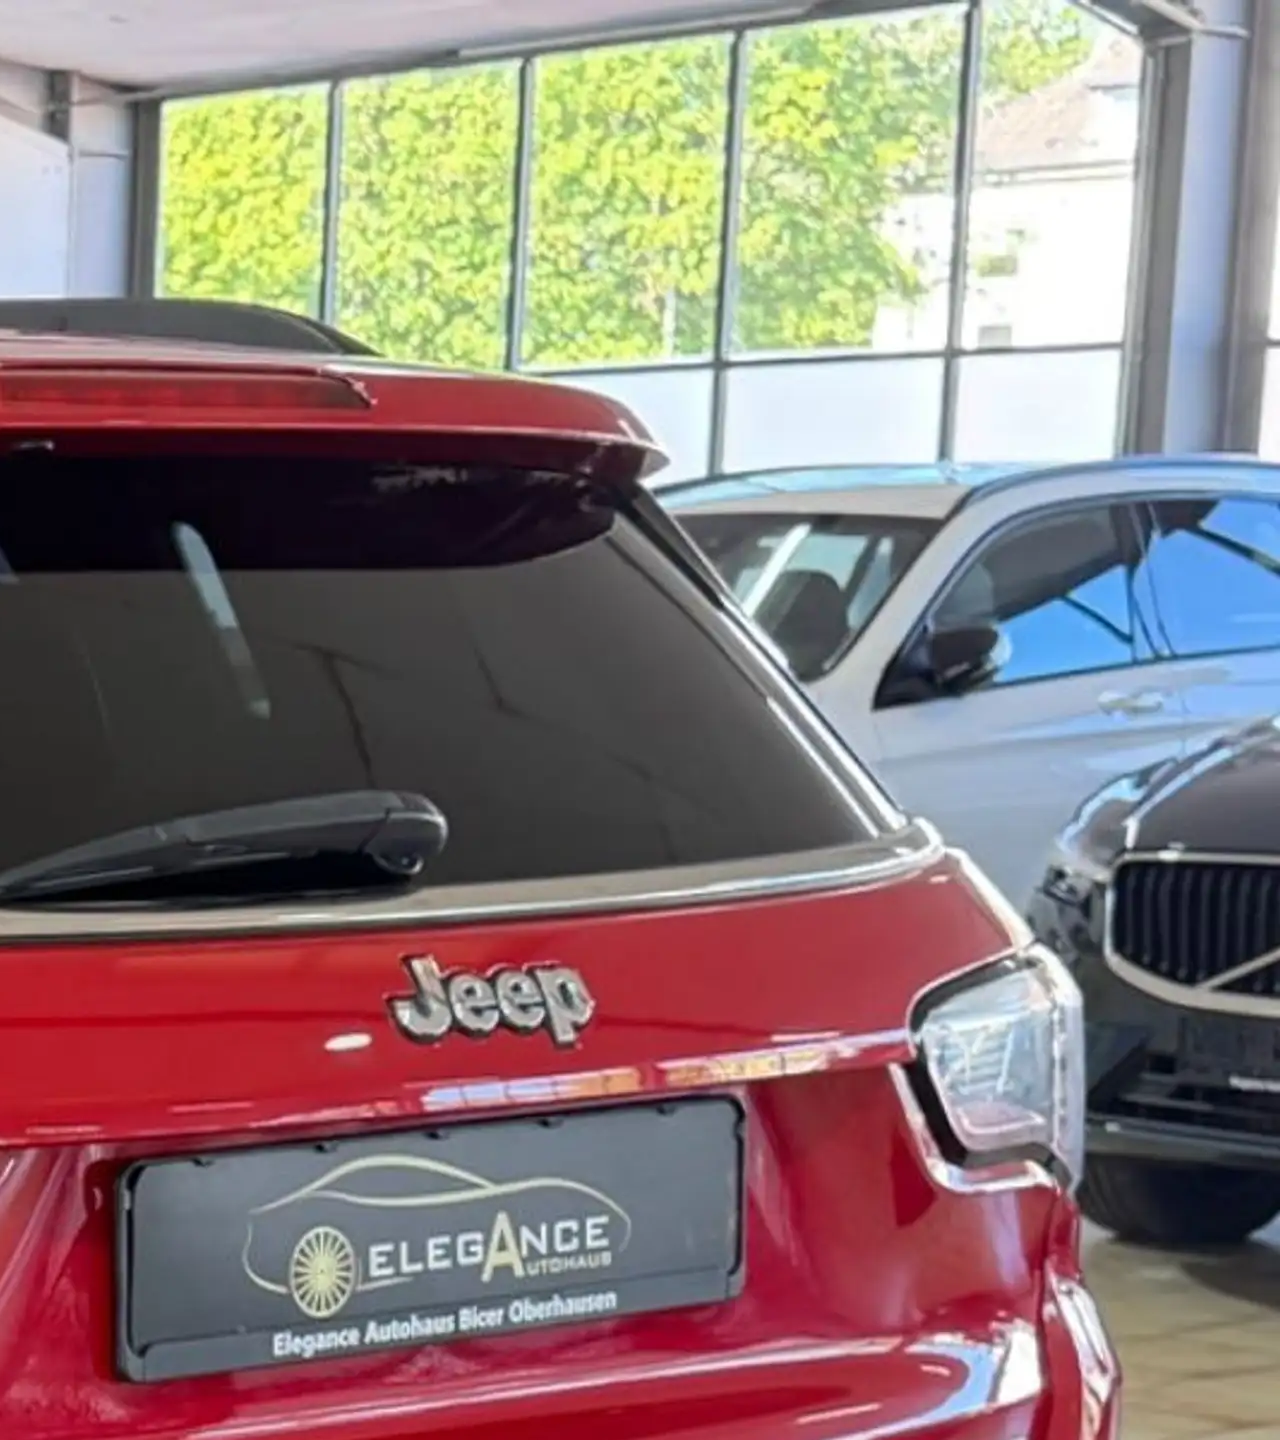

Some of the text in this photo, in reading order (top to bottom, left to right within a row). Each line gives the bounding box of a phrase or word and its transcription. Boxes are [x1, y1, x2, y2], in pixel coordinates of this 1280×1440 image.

[383, 954, 595, 1047] Jeep
[368, 1210, 610, 1282] ELEGANCE
[272, 1290, 618, 1358] Elegance Autohaus Bicer Oberhausen
